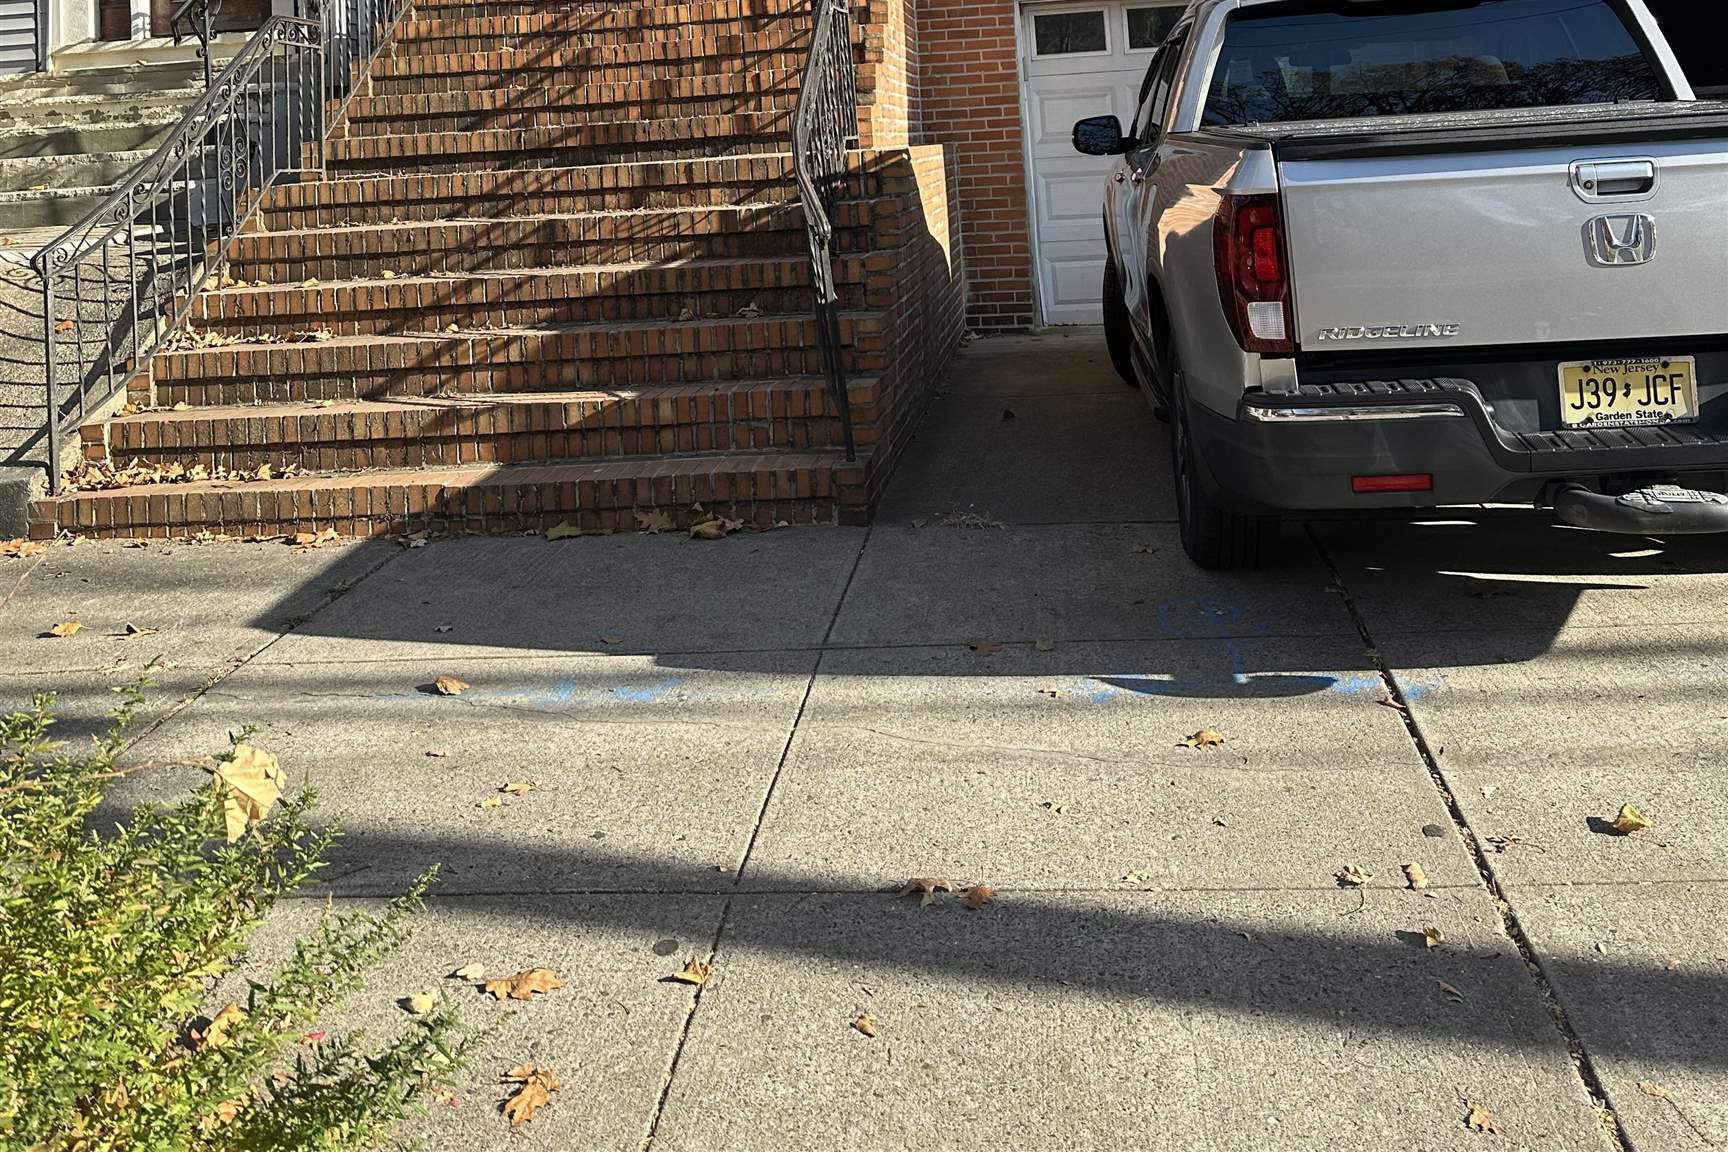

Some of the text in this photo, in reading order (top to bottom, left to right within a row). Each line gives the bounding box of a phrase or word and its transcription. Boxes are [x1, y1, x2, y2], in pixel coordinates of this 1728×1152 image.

[1318, 323, 1461, 340] RIDGELINE
[1593, 363, 1660, 375] New Jersey
[1570, 373, 1684, 410] J39 JCF
[1595, 409, 1664, 421] Garden State
